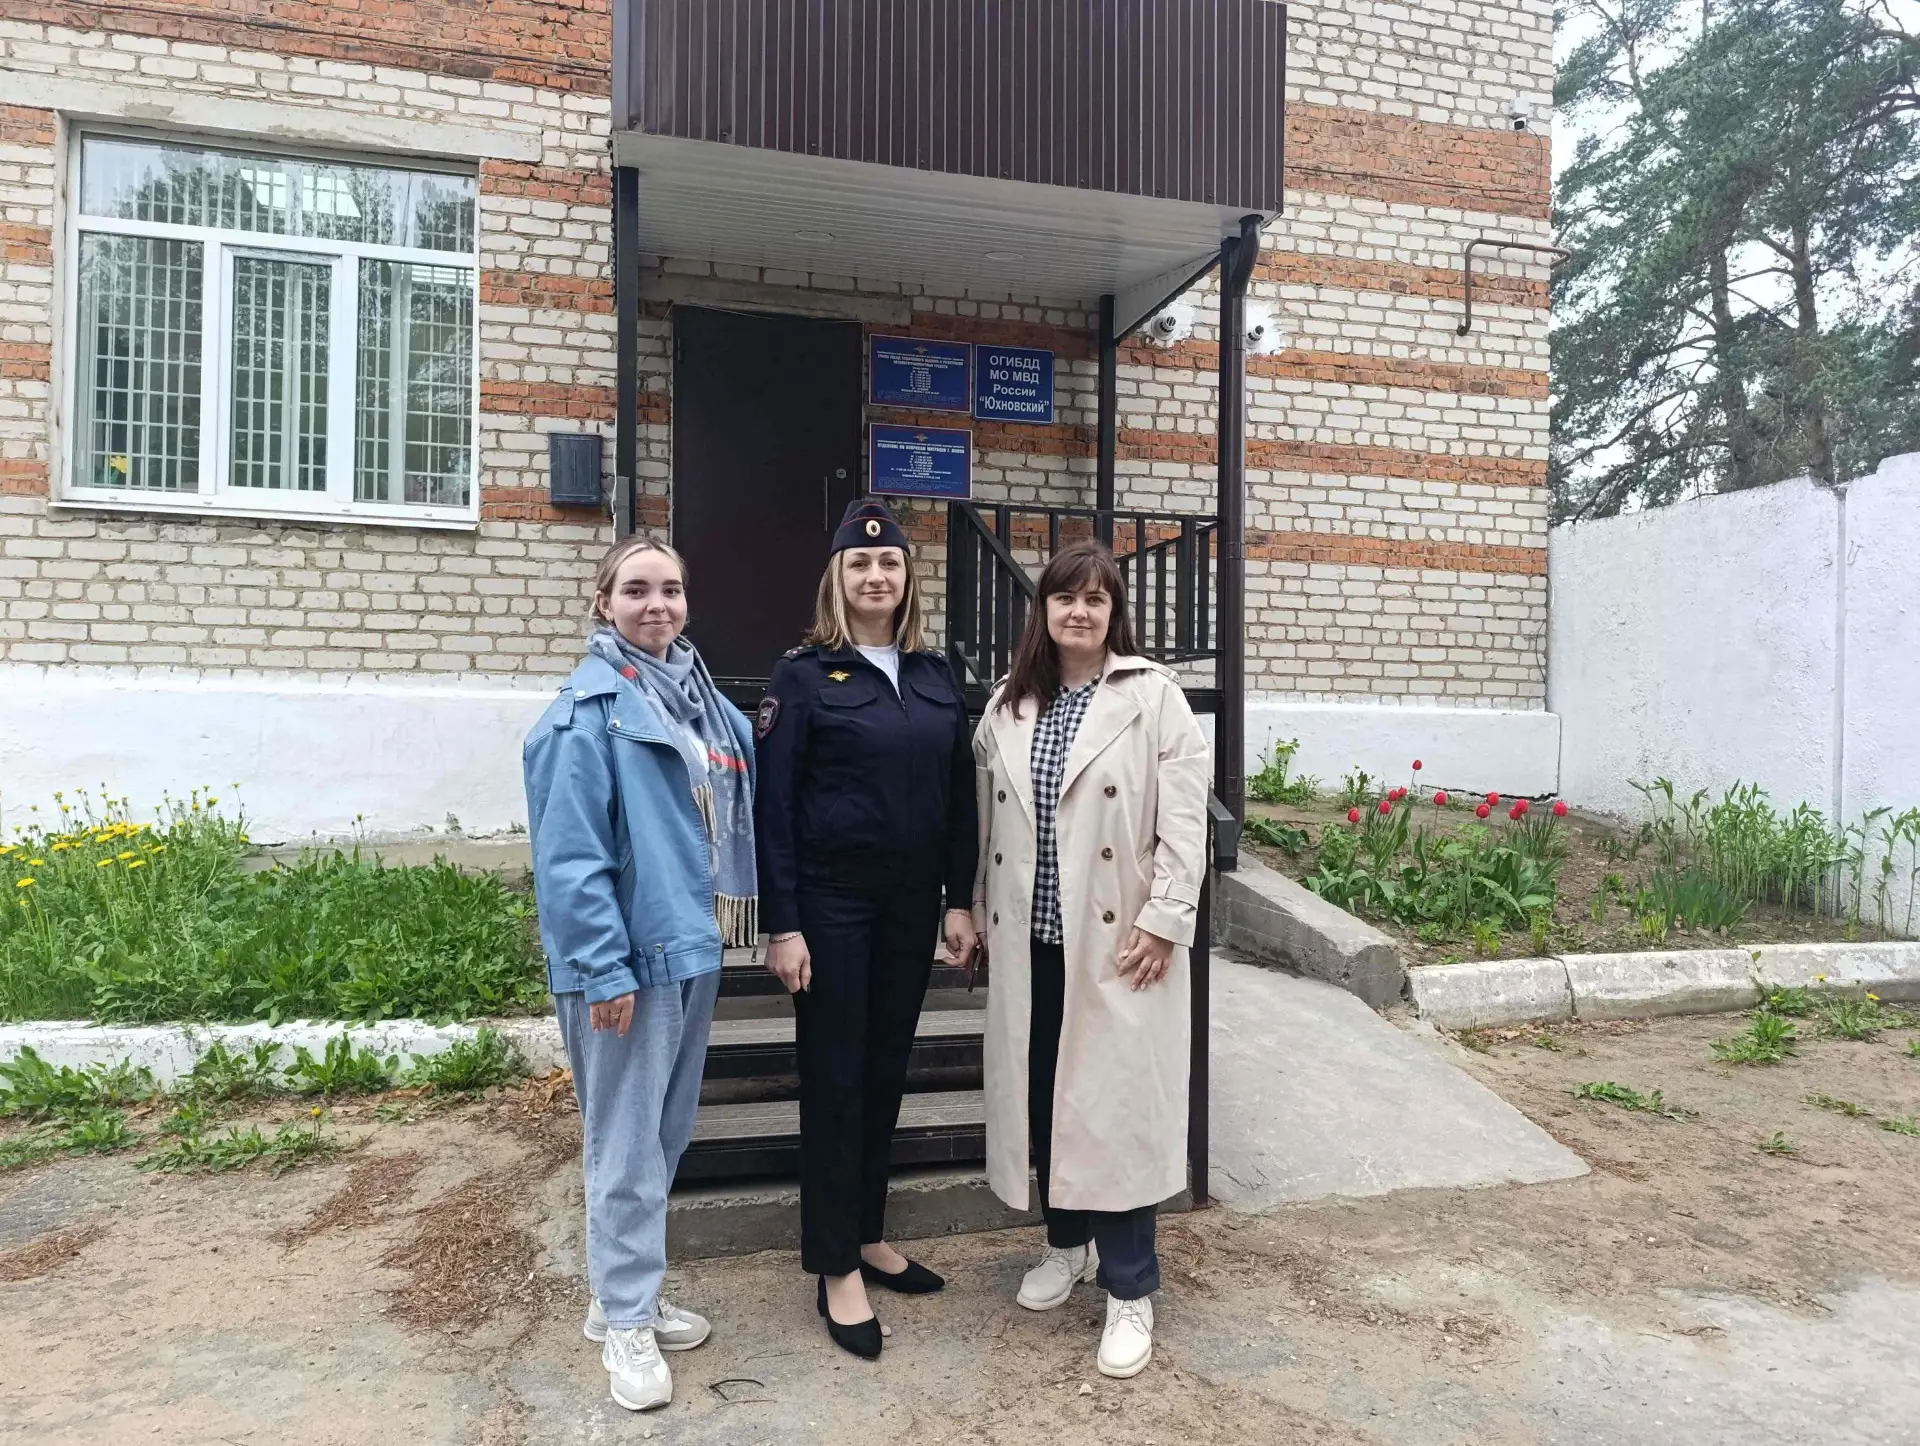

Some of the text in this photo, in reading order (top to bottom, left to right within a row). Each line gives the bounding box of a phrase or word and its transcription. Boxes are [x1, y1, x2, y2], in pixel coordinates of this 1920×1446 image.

[990, 355, 1040, 371] ОГИБДД
[990, 370, 1039, 384] МО МВД
[993, 384, 1036, 397] России
